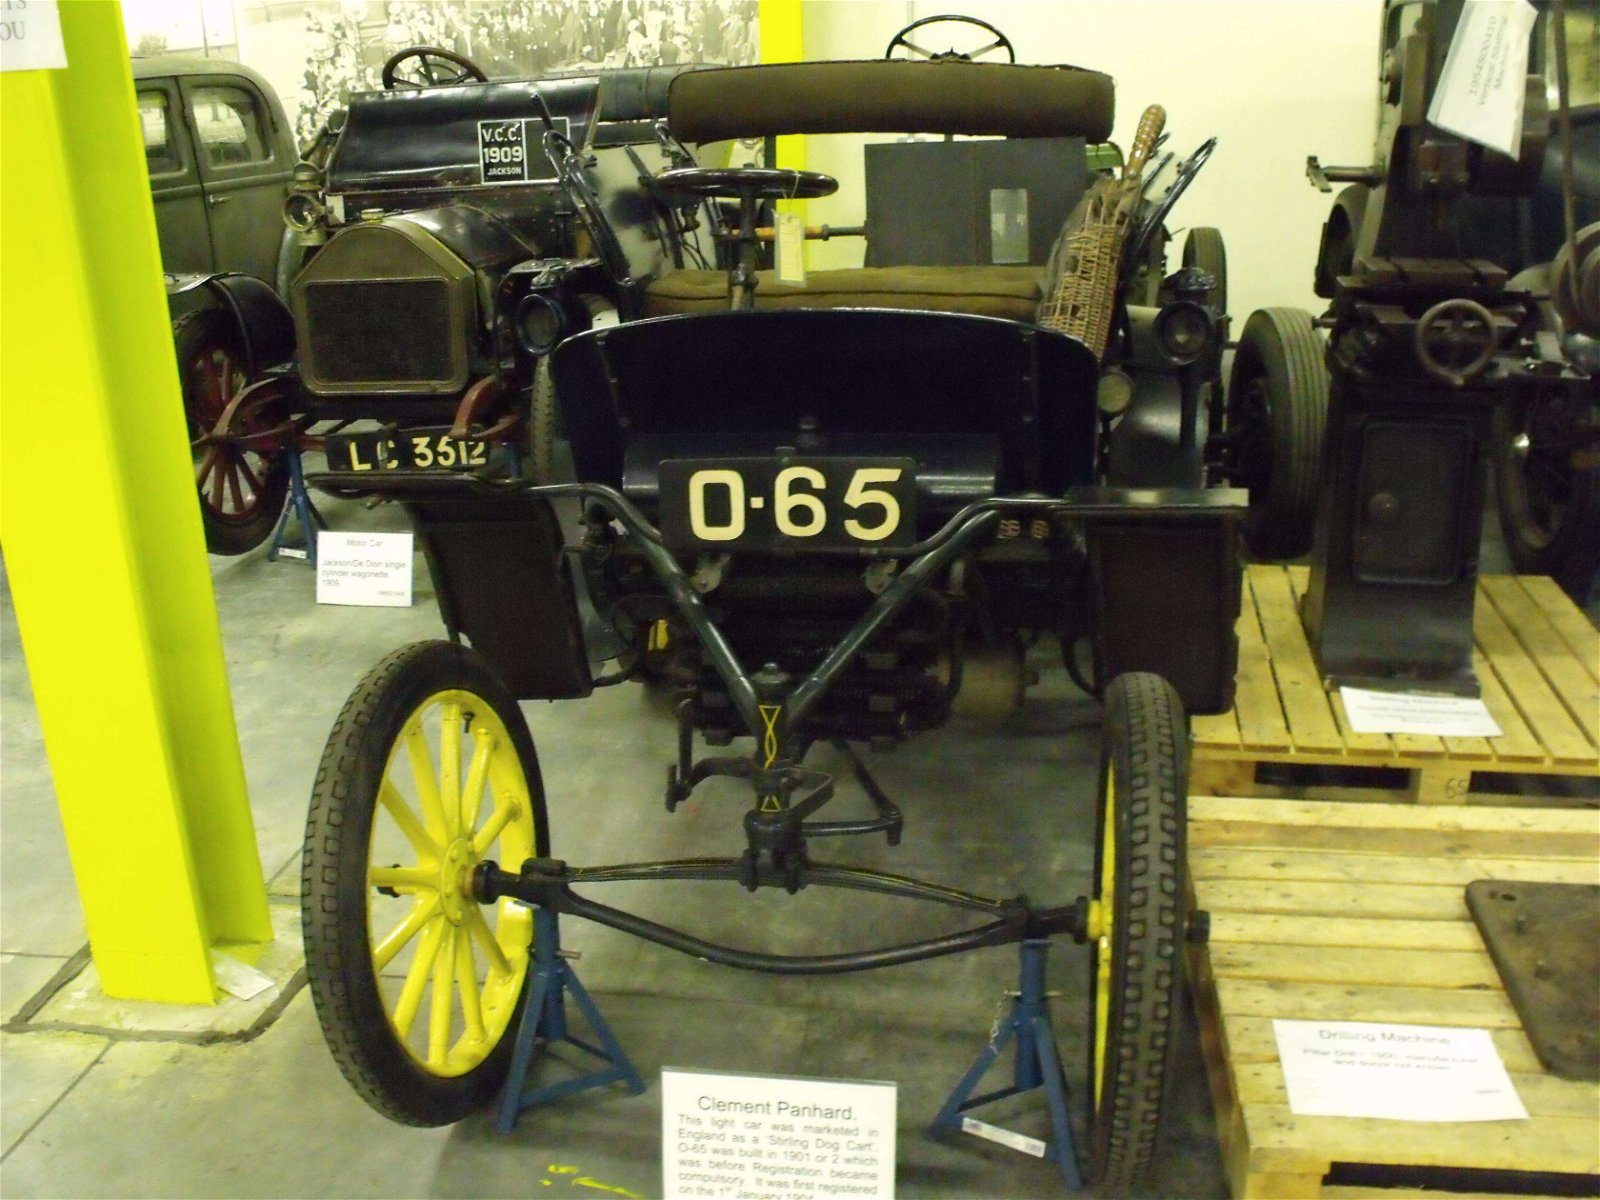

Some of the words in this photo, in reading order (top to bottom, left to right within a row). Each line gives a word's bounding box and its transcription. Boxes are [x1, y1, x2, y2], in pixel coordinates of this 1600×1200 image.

[481, 127, 521, 142] V.C.C.
[483, 146, 523, 163] 1909
[487, 166, 521, 176] JACKSON
[698, 1095, 772, 1115] Clement
[679, 1113, 703, 1126] This
[710, 1117, 736, 1130] light
[744, 1121, 761, 1130] car
[770, 1123, 795, 1132] was
[803, 1124, 859, 1137] marketed
[868, 1128, 879, 1138] in
[678, 1128, 727, 1143] England
[731, 1134, 745, 1143] as
[752, 1136, 760, 1145] a
[815, 1138, 840, 1152] Dog
[711, 1147, 735, 1156] was
[739, 1147, 763, 1158] built
[766, 1149, 778, 1159] in
[815, 1154, 827, 1163] or
[831, 1153, 840, 1165] 2
[843, 1156, 878, 1167] which
[678, 1158, 702, 1168] was
[708, 1159, 745, 1172] before
[753, 1161, 823, 1177] Registration
[830, 1167, 879, 1181] became
[678, 1184, 693, 1195] on
[696, 1185, 715, 1197] the
[766, 1179, 790, 1189] was
[793, 1179, 815, 1191] first
[818, 1182, 879, 1196] registered
